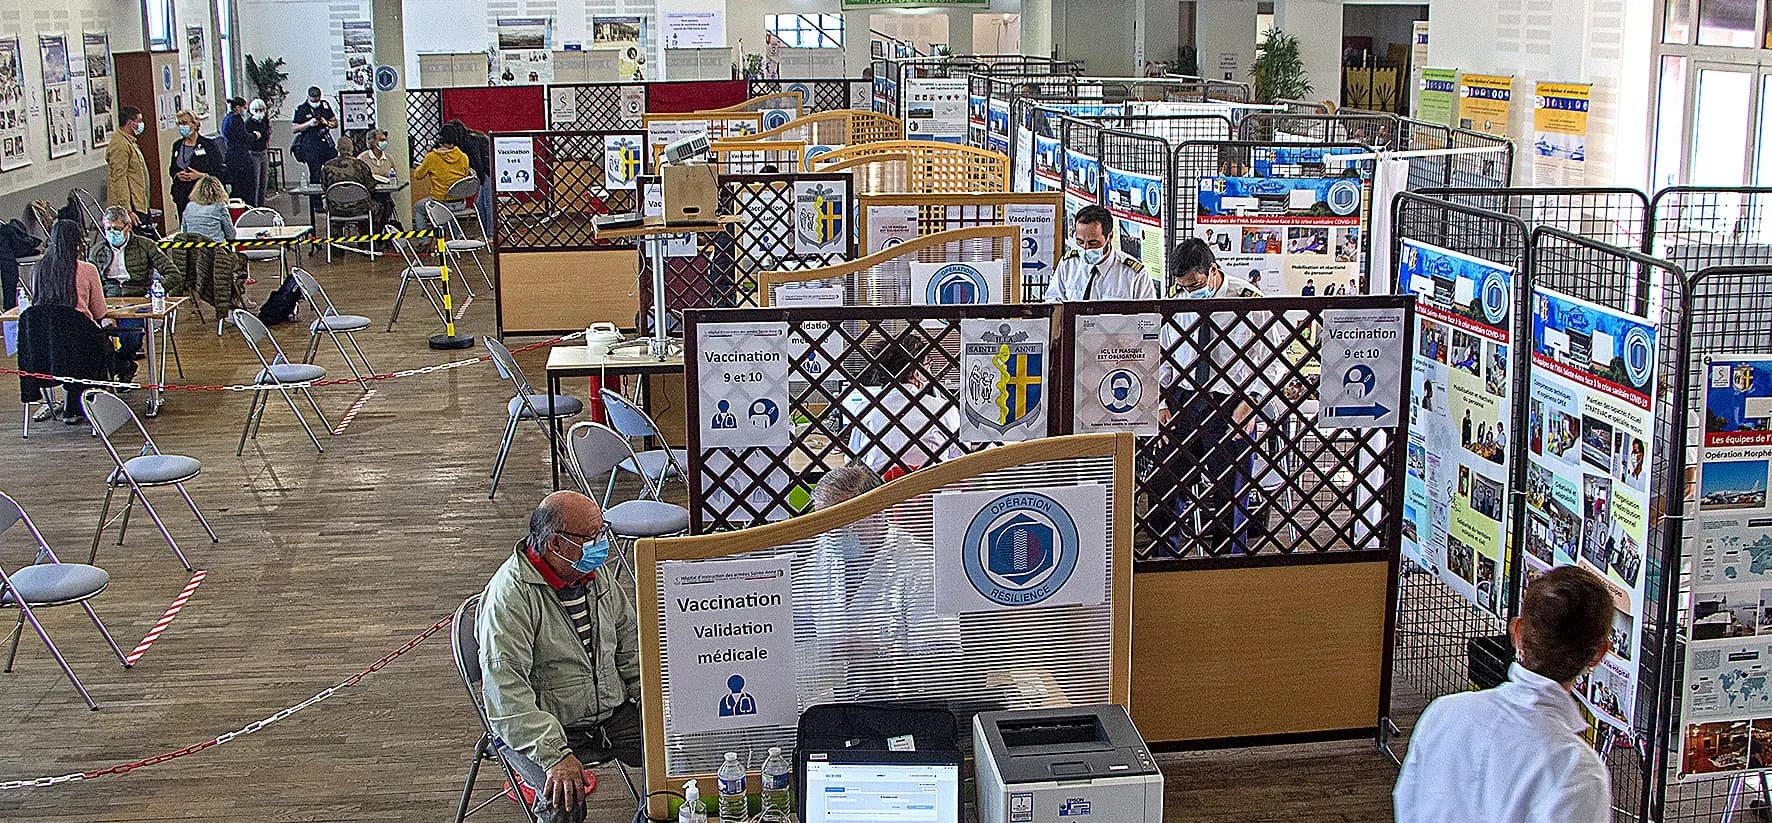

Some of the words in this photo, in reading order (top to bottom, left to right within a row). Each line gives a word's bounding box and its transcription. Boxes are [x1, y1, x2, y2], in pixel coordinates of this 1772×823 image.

[1008, 215, 1051, 224] Vaccination
[1329, 327, 1397, 340] Vaccination
[969, 345, 997, 353] SAINTE
[1014, 345, 1036, 353] ANNE
[1344, 349, 1351, 358] 9
[1353, 349, 1365, 358] et
[1367, 348, 1380, 358] 10
[704, 350, 780, 363] Vaccination
[723, 373, 731, 382] 9
[733, 373, 746, 382] et
[748, 372, 762, 382] 10
[1725, 435, 1754, 446] équipes
[1755, 434, 1765, 443] de
[1705, 451, 1742, 460] Opération
[991, 497, 1052, 515] OPÉRATION
[990, 585, 1051, 603] RÉSILIENCE
[676, 592, 781, 613] Vaccination
[693, 621, 773, 639] Validation
[697, 647, 768, 664] médicale
